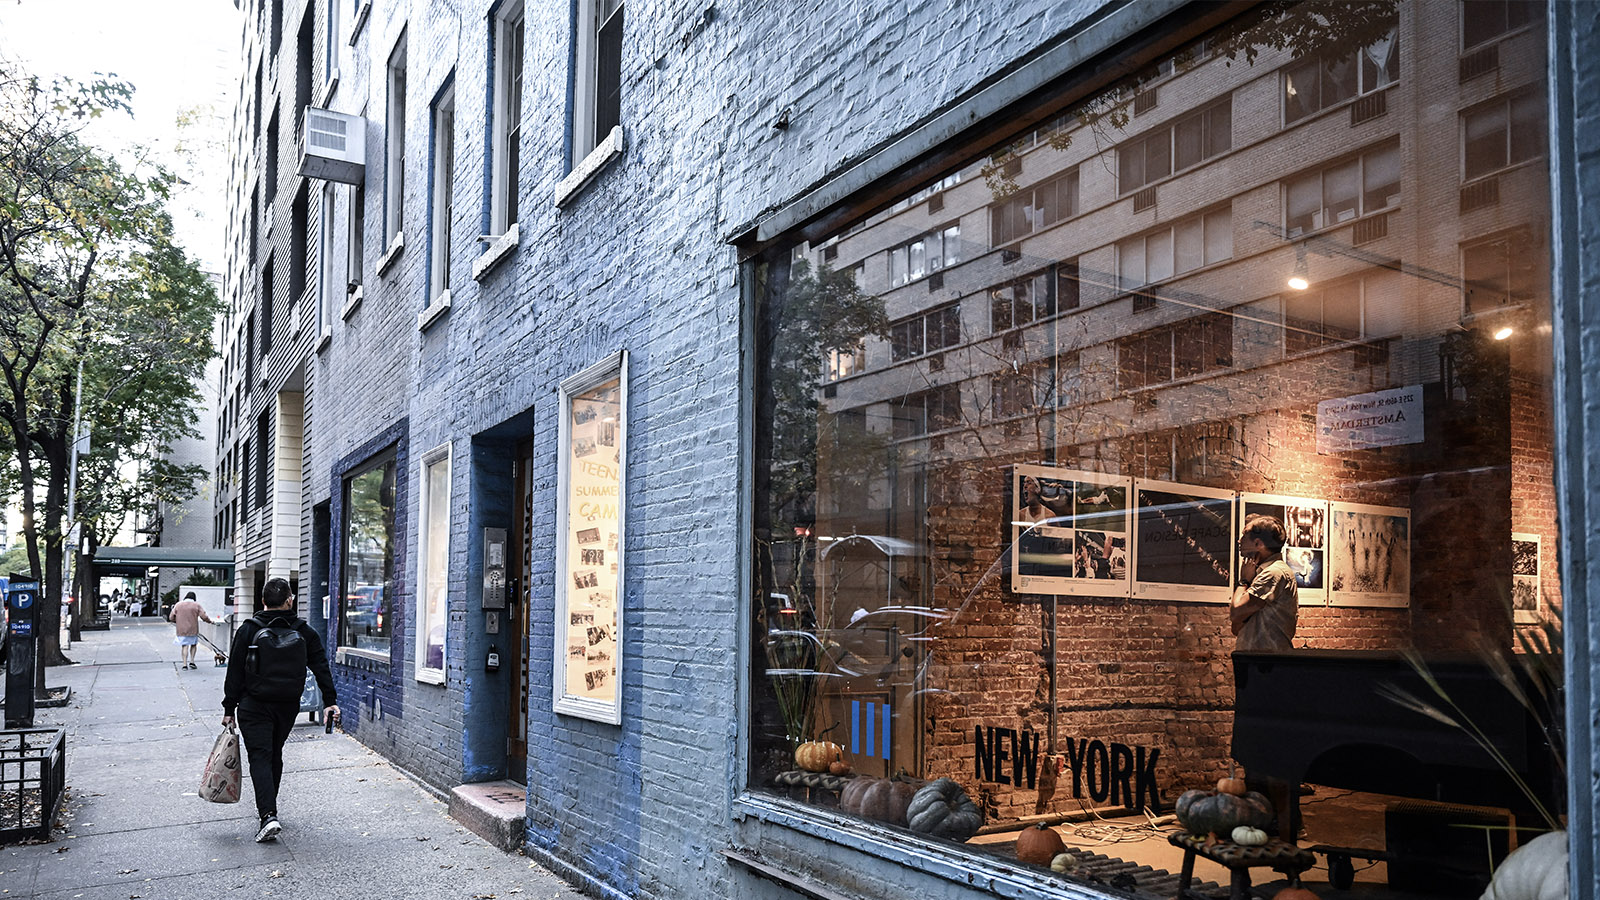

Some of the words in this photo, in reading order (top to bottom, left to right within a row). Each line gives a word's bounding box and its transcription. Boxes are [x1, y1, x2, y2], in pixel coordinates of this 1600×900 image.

[579, 459, 619, 481] TEEN
[576, 485, 619, 497] SUMME
[18, 593, 29, 607] P
[975, 724, 1040, 790] NEW
[1066, 735, 1161, 815] YORK
